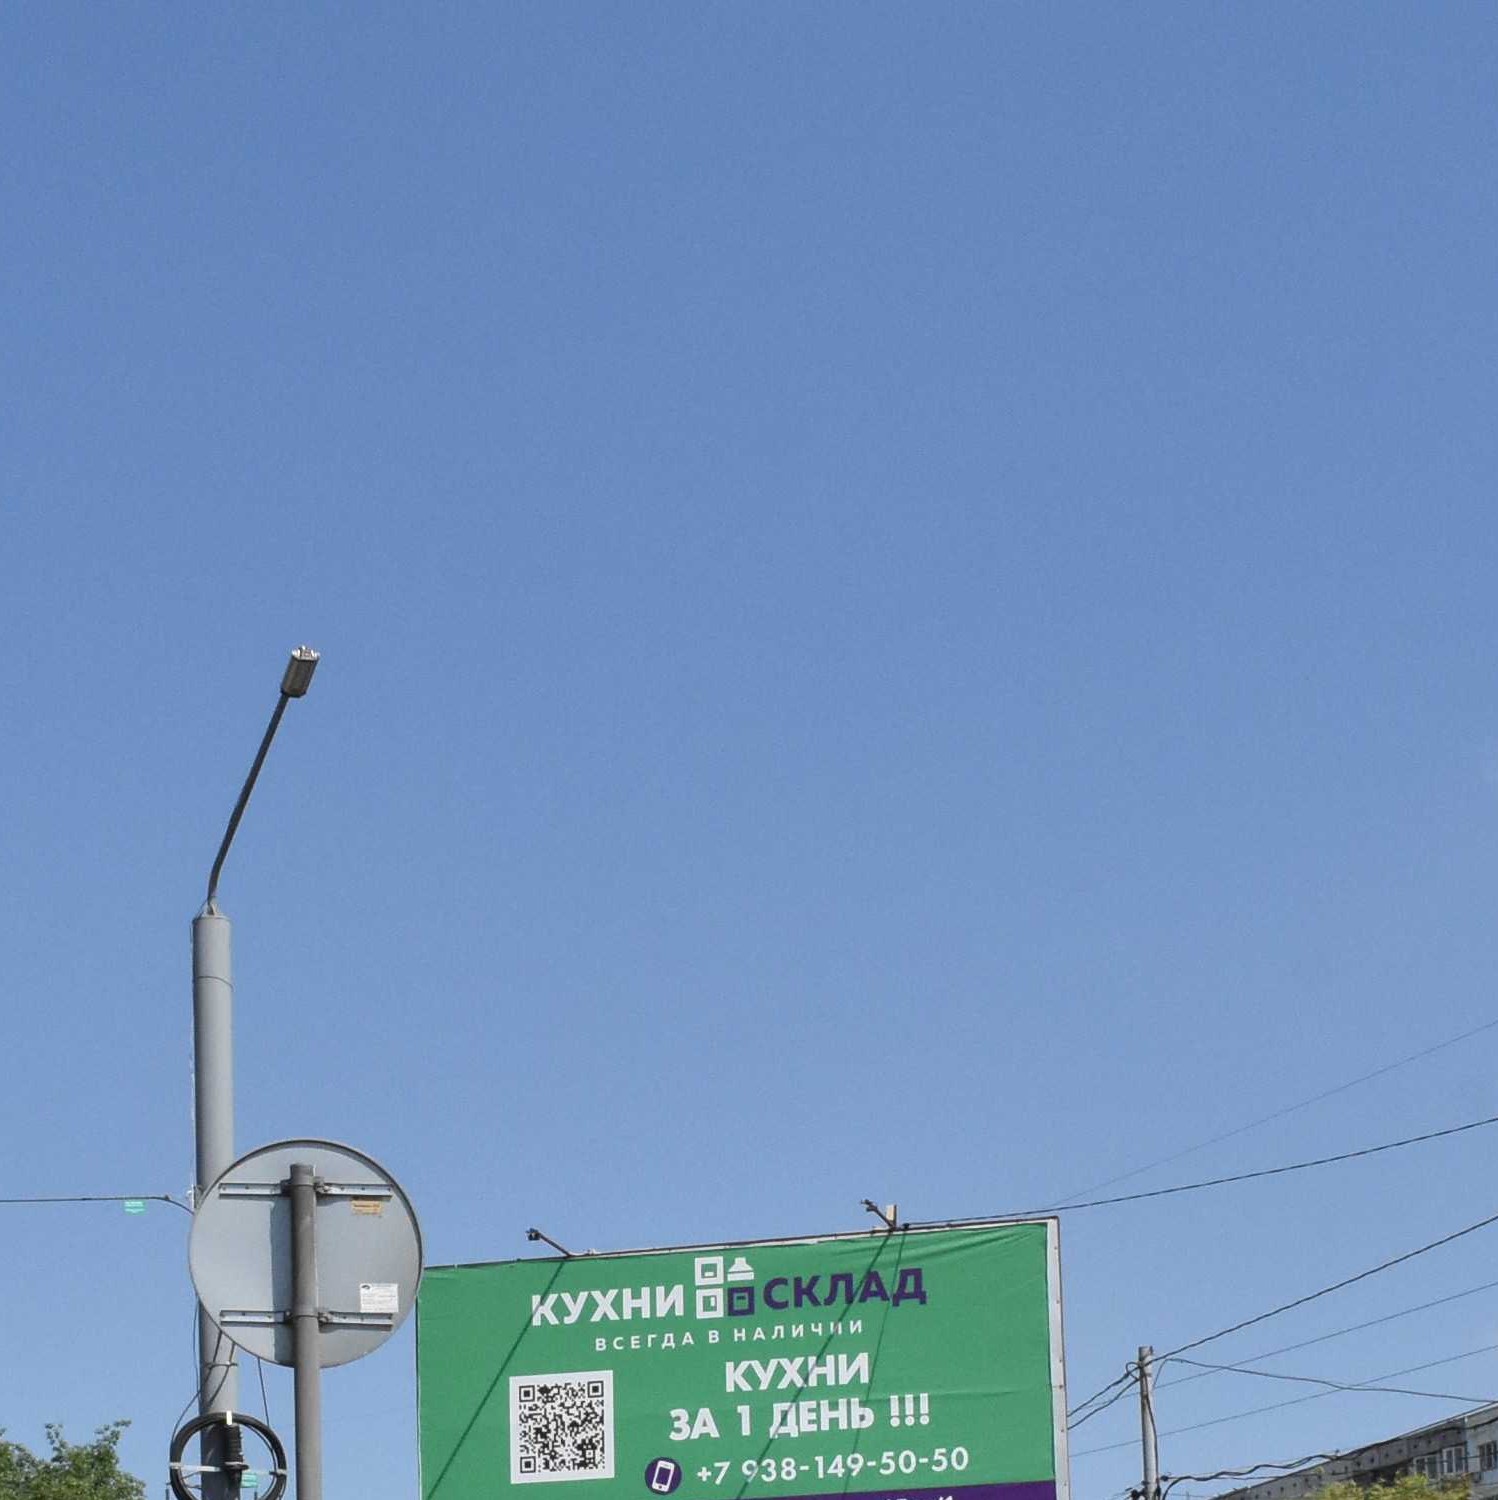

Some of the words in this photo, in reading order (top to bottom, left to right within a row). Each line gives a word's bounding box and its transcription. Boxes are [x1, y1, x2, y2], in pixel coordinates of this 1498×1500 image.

[531, 1284, 685, 1326] КУХНИ
[763, 1267, 928, 1310] СКЛАД
[595, 1330, 694, 1351] ВСЕГДА
[708, 1330, 720, 1344] В
[733, 1319, 864, 1342] НАЛИЧИИ
[725, 1352, 870, 1392] КУХНИ
[669, 1407, 720, 1441] ЗА
[737, 1405, 751, 1436] 1
[769, 1398, 875, 1439] ДЕНЬ
[697, 1461, 730, 1485] +7
[741, 1446, 969, 1484] 938-149-50-50
